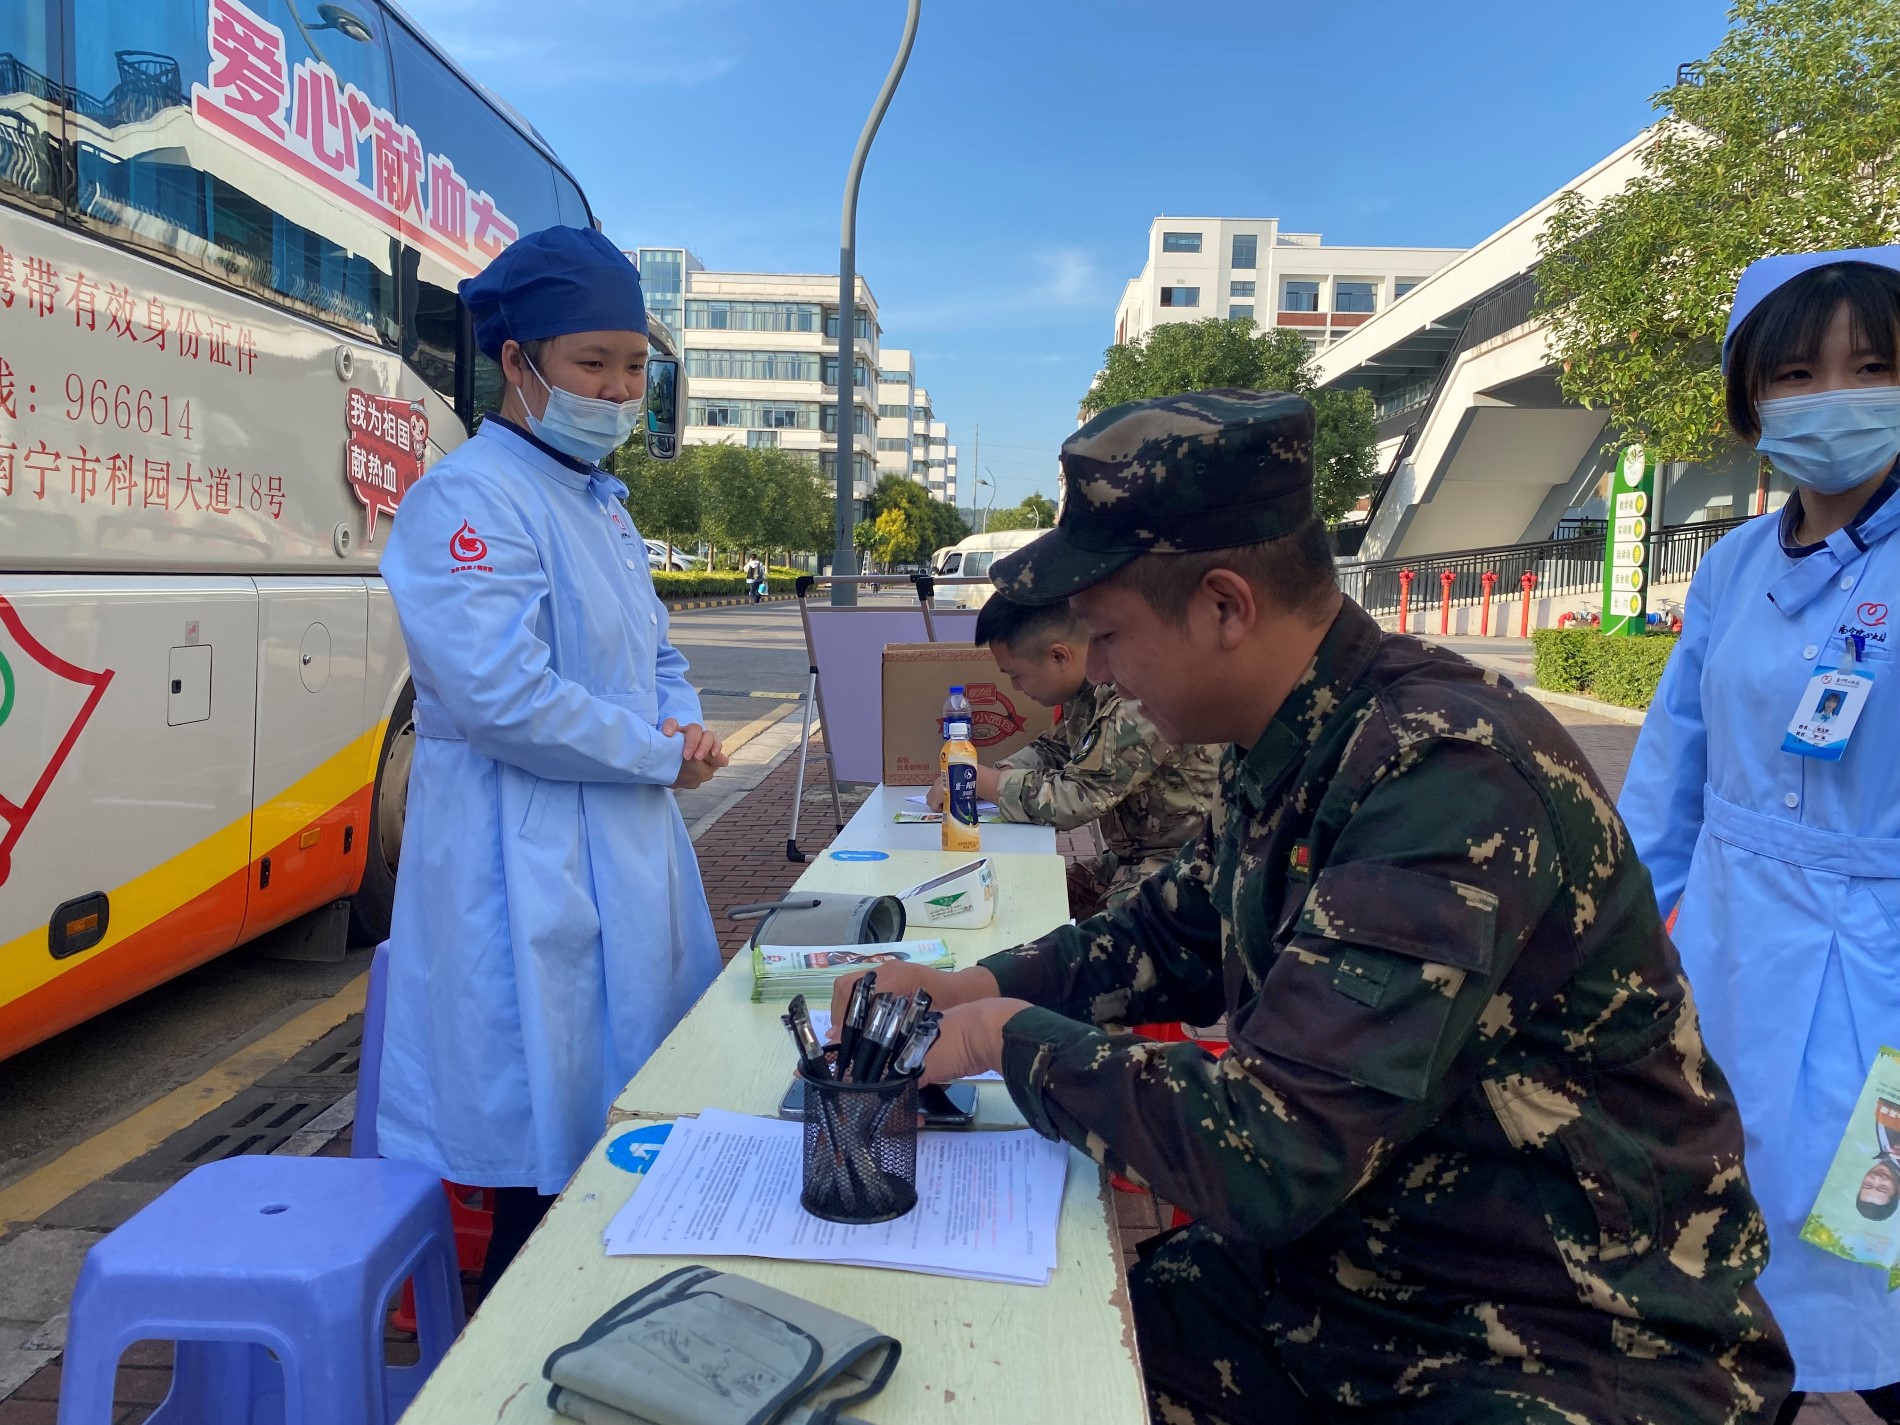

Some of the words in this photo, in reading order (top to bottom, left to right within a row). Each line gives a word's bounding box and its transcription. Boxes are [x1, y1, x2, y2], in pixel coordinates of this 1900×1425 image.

[350, 393, 411, 453] 我为祖国
[350, 444, 398, 494] 献热血
